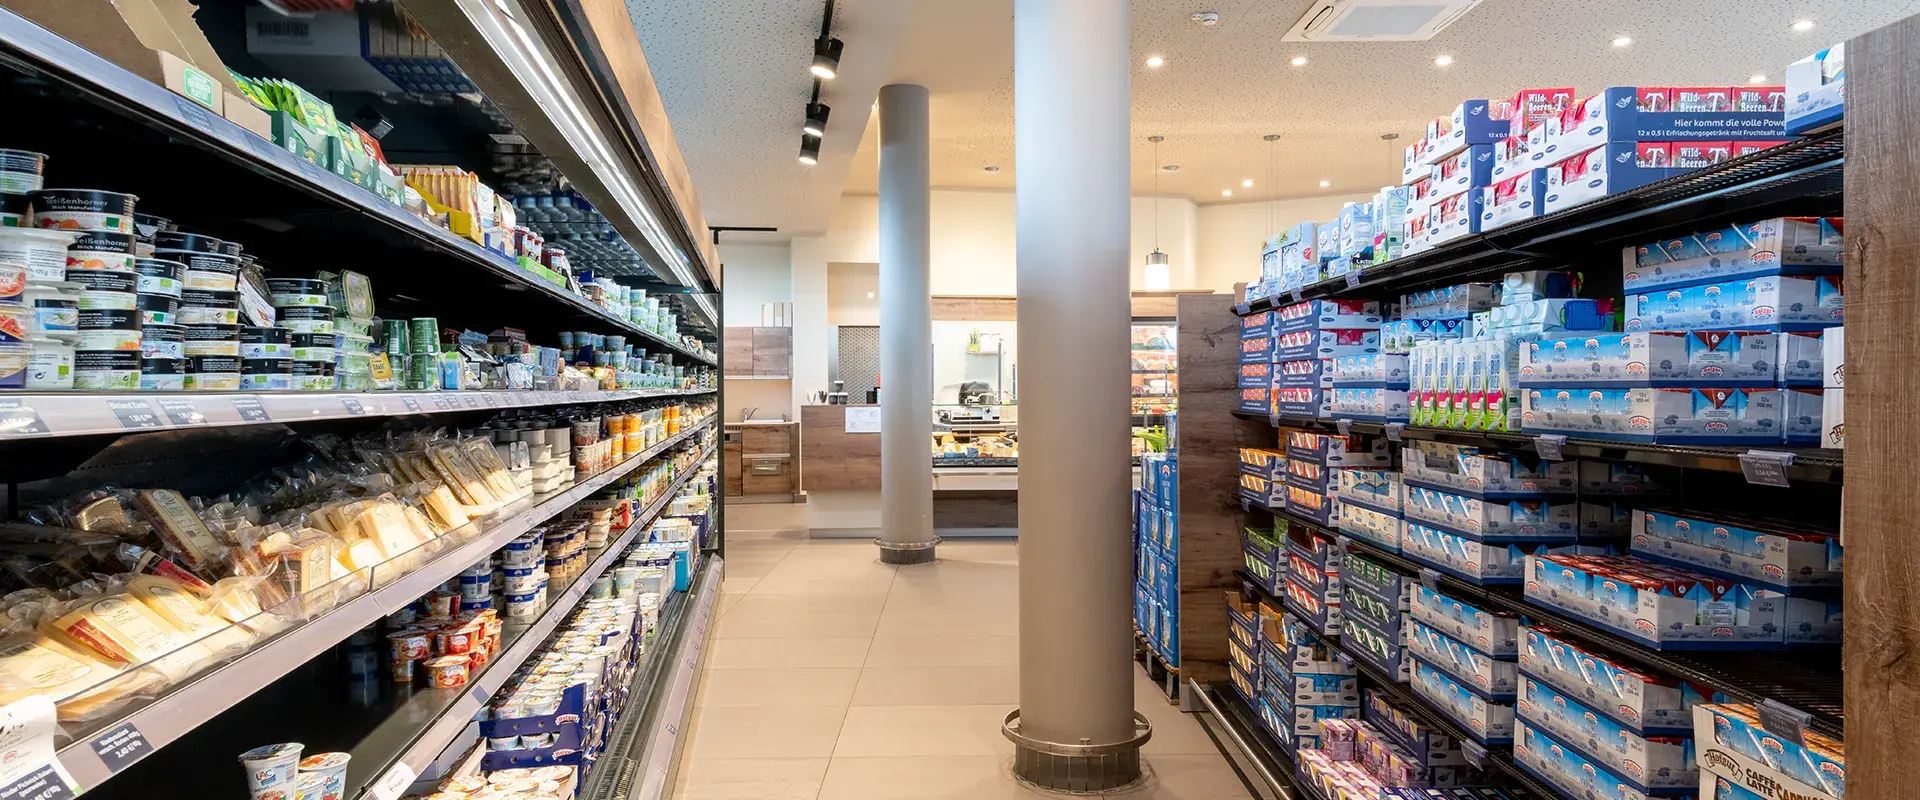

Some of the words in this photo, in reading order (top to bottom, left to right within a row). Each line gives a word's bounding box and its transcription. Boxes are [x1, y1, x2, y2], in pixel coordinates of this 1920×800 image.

[1680, 92, 1701, 102] Wild-
[1740, 92, 1762, 102] Wild-
[1528, 102, 1553, 111] Beeren
[1680, 103, 1706, 112] Beeren
[1740, 103, 1768, 112] Beeren
[1674, 119, 1691, 127] Hier
[1693, 119, 1721, 127] kommt
[1723, 119, 1738, 127] die
[1740, 119, 1762, 127] volle
[1763, 119, 1785, 127] Powe
[1666, 129, 1730, 138] Erfrischungsgetränk
[1743, 129, 1773, 137] Fruchtsaft
[1681, 148, 1701, 157] Wild-
[1681, 158, 1707, 168] Beeren
[43, 196, 108, 207] Weißenhorner
[1752, 251, 1773, 261] Hofgut
[1754, 308, 1773, 316] Hofgut
[1763, 562, 1785, 578] Hofgut
[115, 747, 130, 758] 2,40
[1710, 752, 1740, 778] Hofgut
[256, 769, 276, 781] LAC
[1746, 768, 1776, 790] CAFFÈ
[1746, 777, 1774, 798] LATTE
